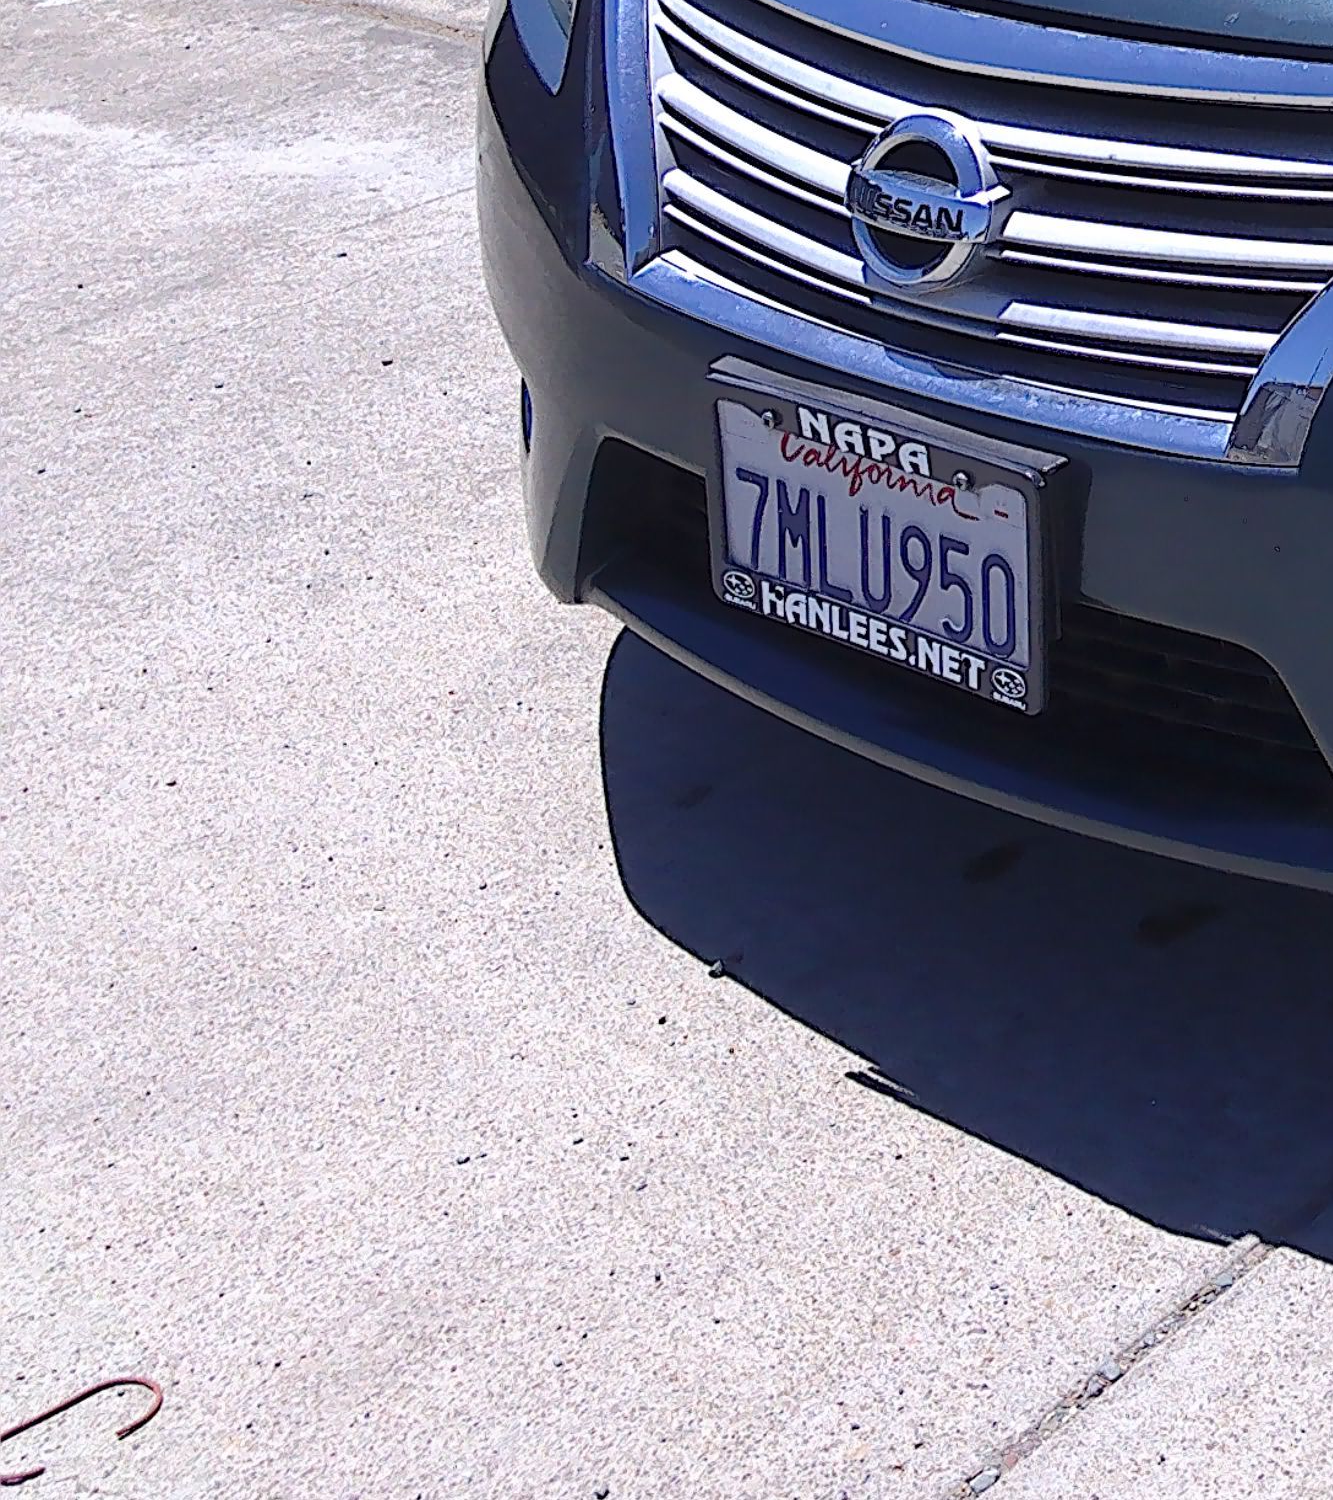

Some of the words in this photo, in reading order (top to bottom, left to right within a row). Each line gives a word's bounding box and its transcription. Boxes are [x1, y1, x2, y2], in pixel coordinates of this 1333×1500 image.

[779, 430, 980, 522] California
[798, 406, 930, 477] NAPA
[735, 466, 1016, 658] 7MLU950
[760, 580, 986, 691] HANLEES.NET
